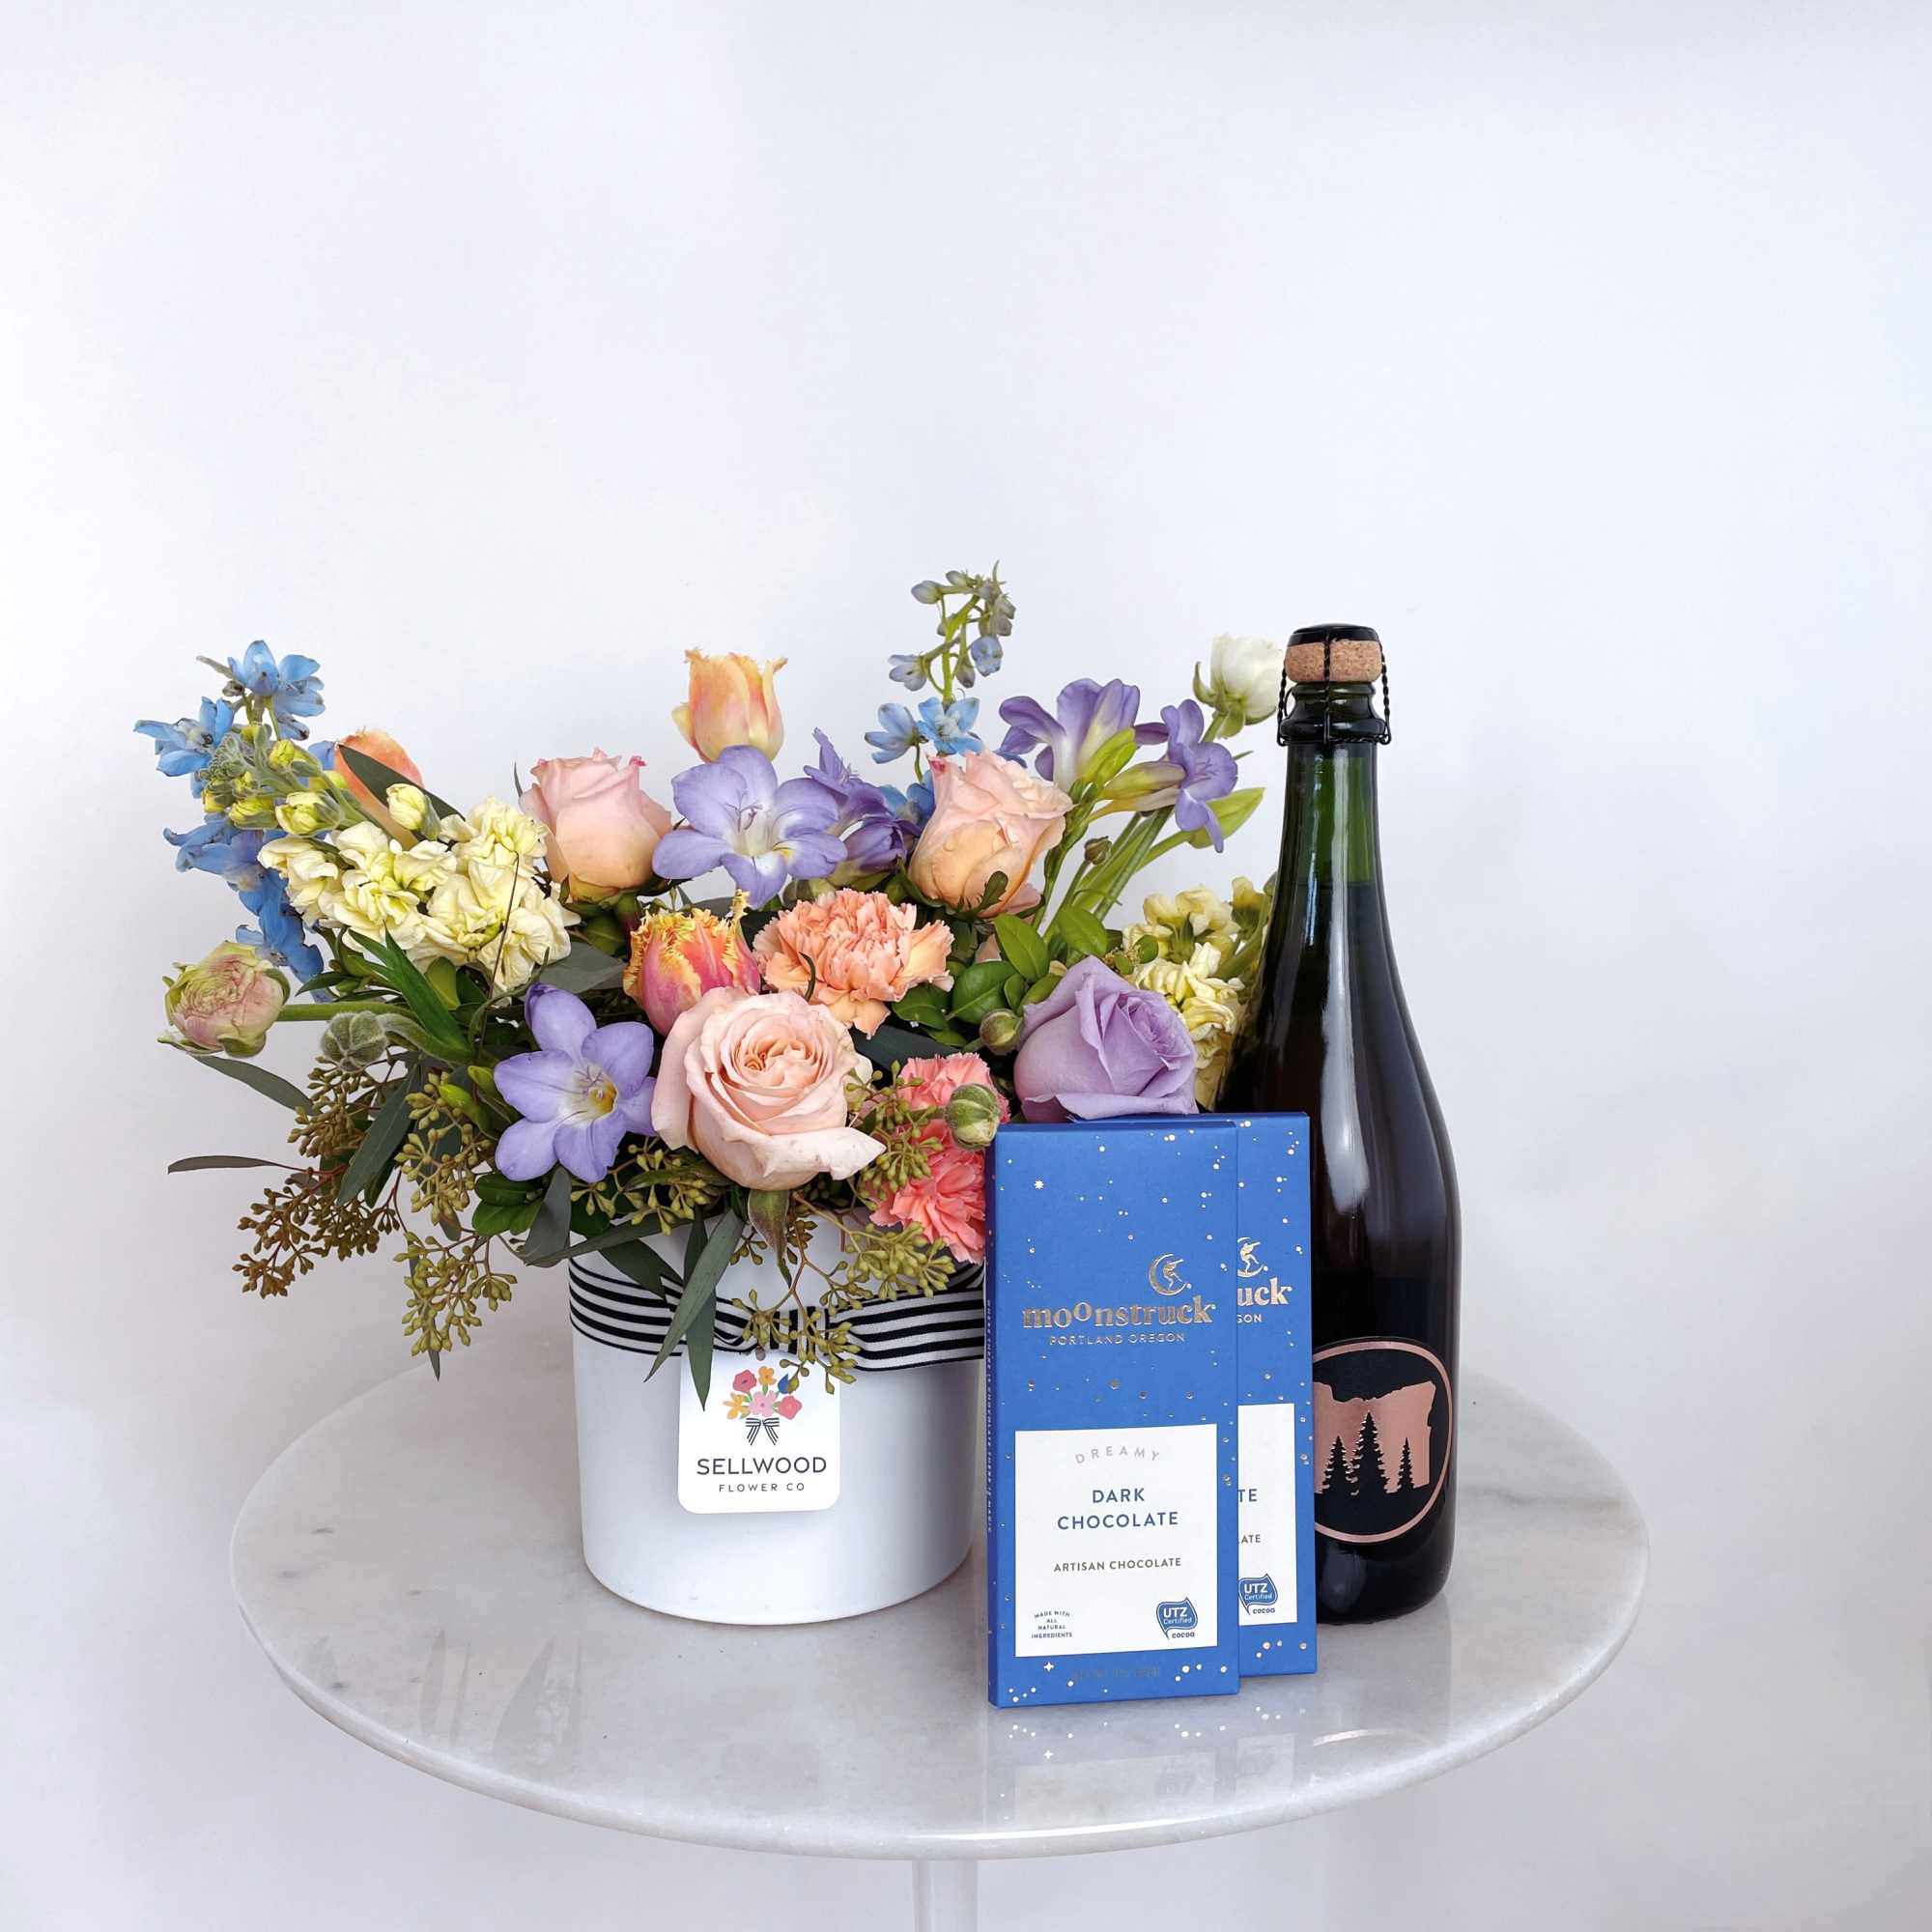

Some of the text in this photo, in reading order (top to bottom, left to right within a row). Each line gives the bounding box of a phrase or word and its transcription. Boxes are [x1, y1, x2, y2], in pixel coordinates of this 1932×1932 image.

[1022, 1294, 1216, 1328] moonstruck
[1050, 1332, 1185, 1346] PORTLAND OREGON
[1075, 1445, 1159, 1464] DREAMY
[696, 1457, 827, 1475] SELLWOOD
[719, 1482, 805, 1492] FLOWER CO
[1093, 1488, 1145, 1503] DARK
[1057, 1511, 1179, 1530] CHOCOLATE
[1054, 1557, 1181, 1572] ARTISAN CHOCOLATE
[1243, 1583, 1268, 1594] UTZ
[1163, 1606, 1188, 1618] UTZ
